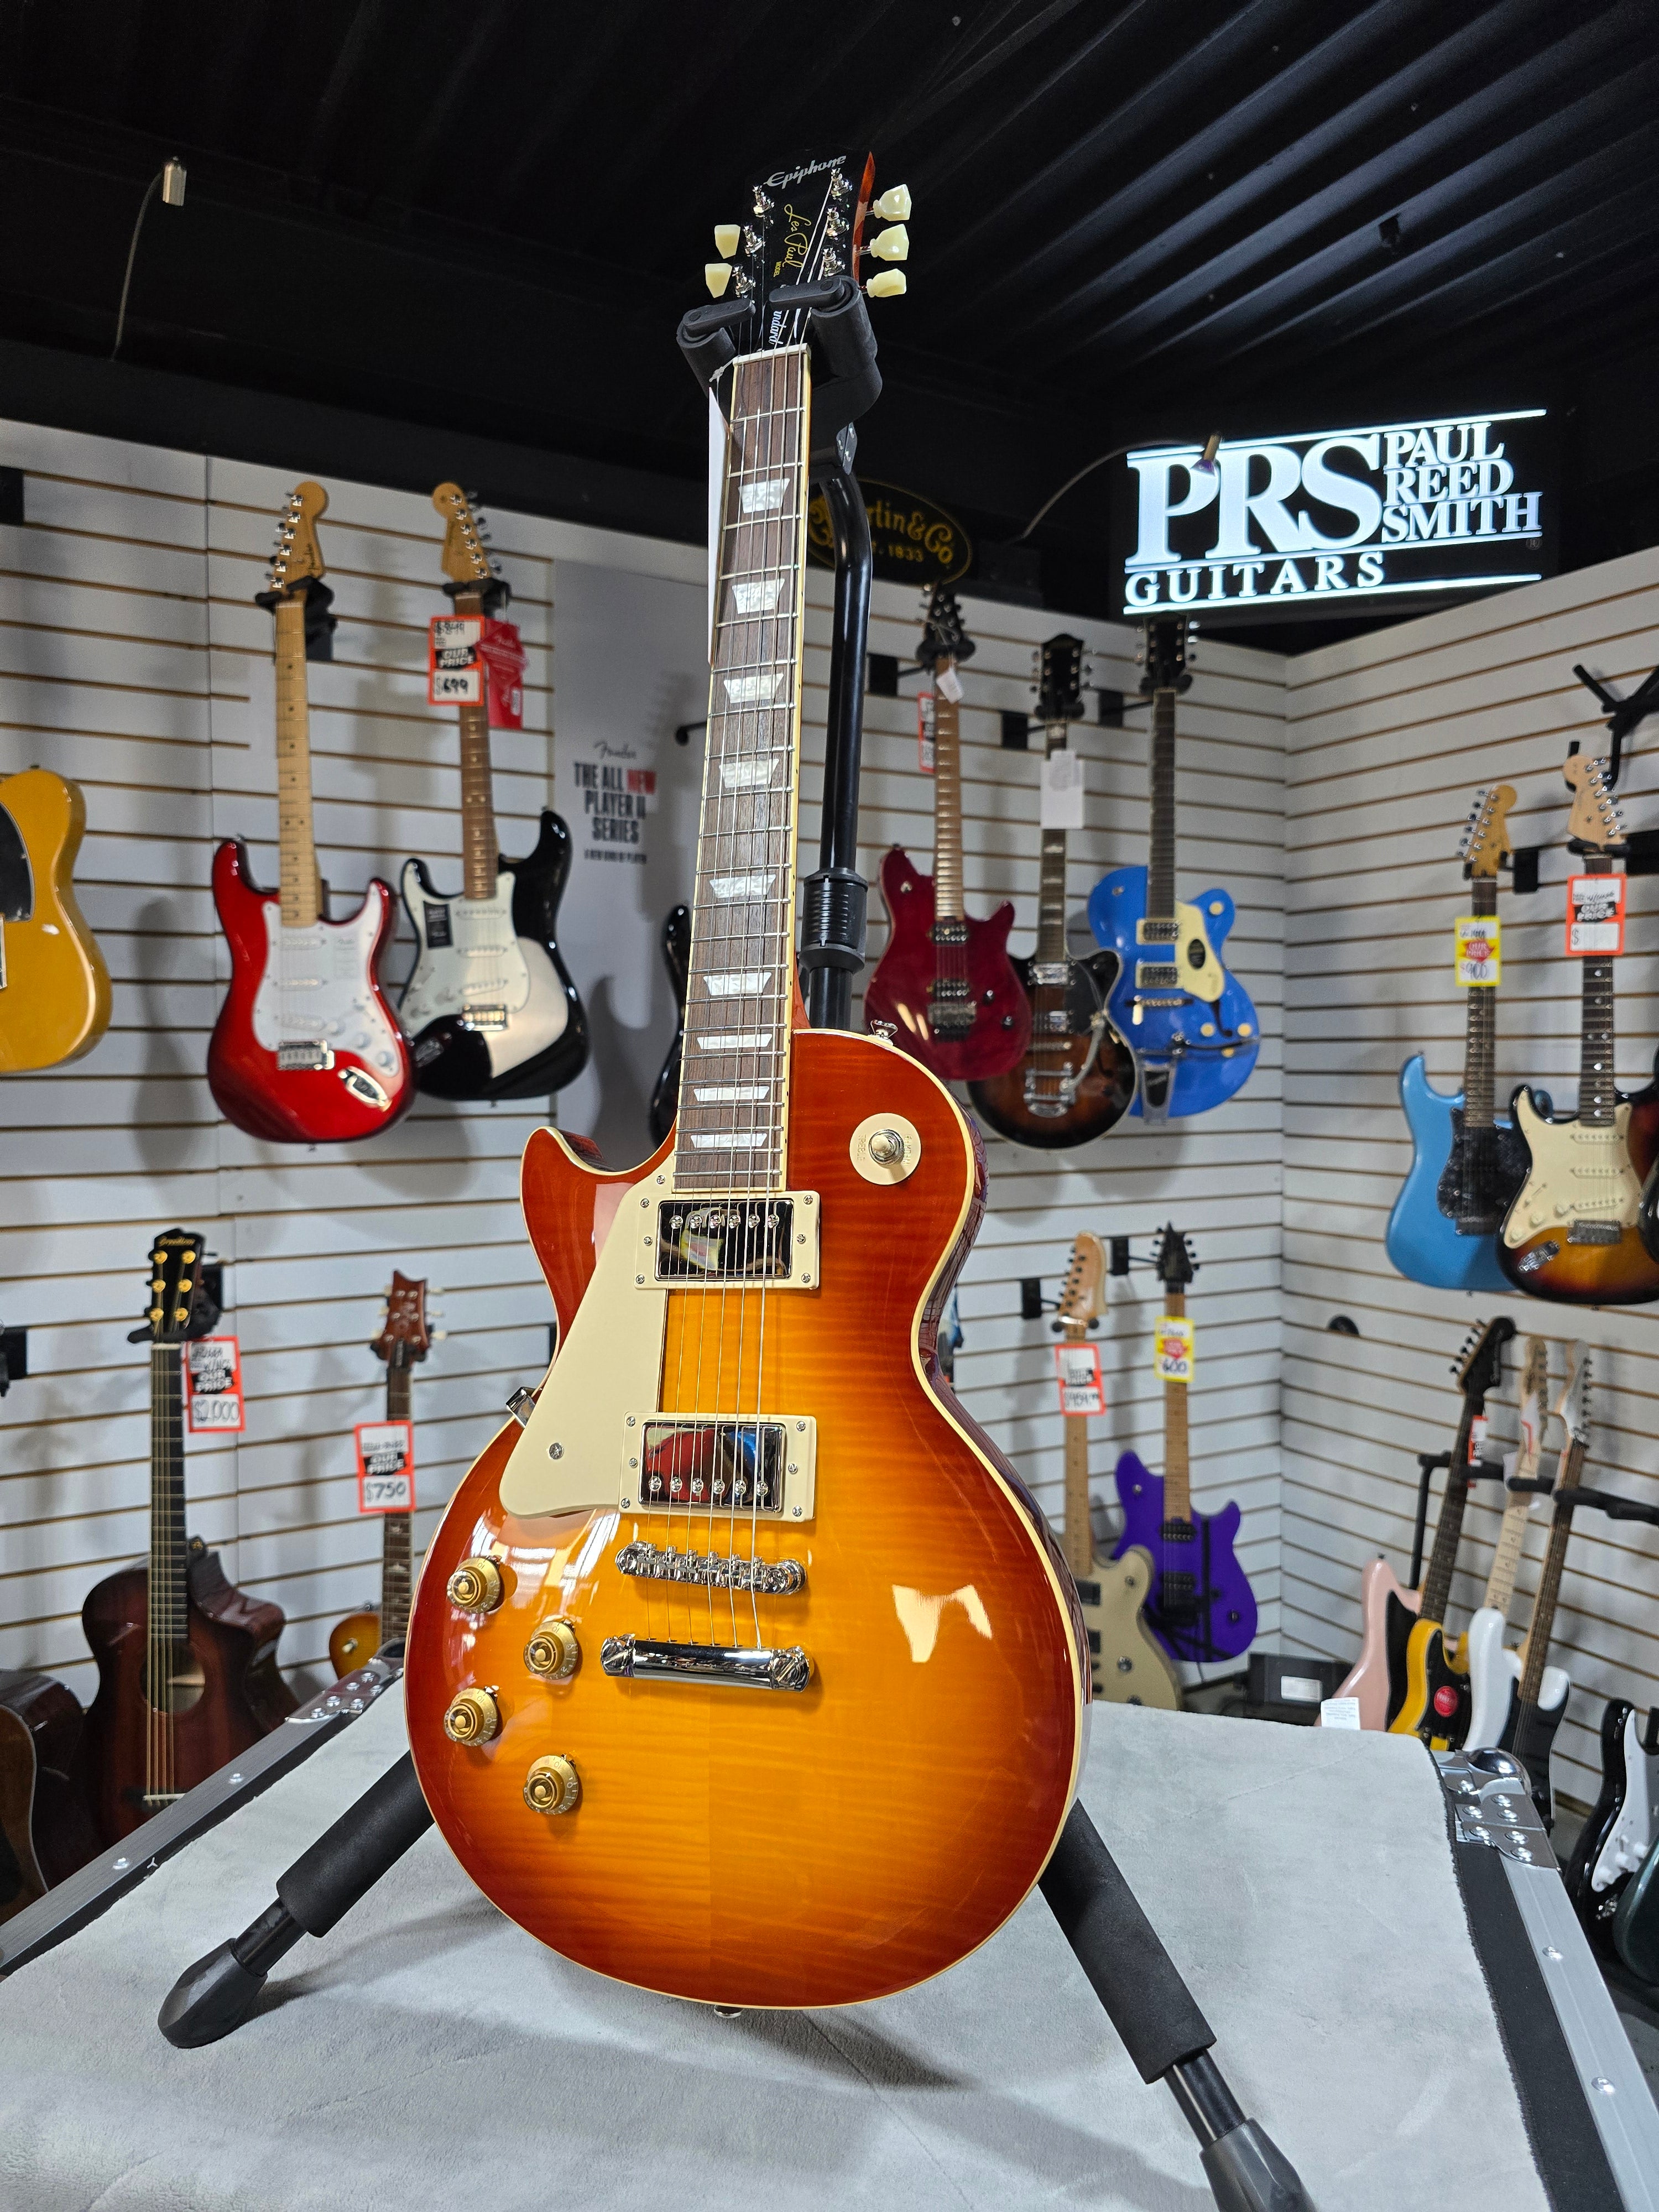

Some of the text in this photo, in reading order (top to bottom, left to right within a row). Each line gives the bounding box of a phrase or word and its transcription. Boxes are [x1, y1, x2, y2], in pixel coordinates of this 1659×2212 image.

[763, 155, 847, 189] Epiphone
[782, 204, 811, 268] Les Paul
[1383, 421, 1505, 470] PAUL
[1125, 434, 1383, 566] PRS
[1383, 459, 1514, 507] REED
[1381, 491, 1543, 544] SMITH
[1125, 551, 1385, 607] GUITARS
[575, 761, 598, 789] THE
[602, 765, 623, 791] ALL
[584, 790, 633, 818] PLAYER
[592, 816, 639, 844] SERIES
[366, 1481, 406, 1503] $750
